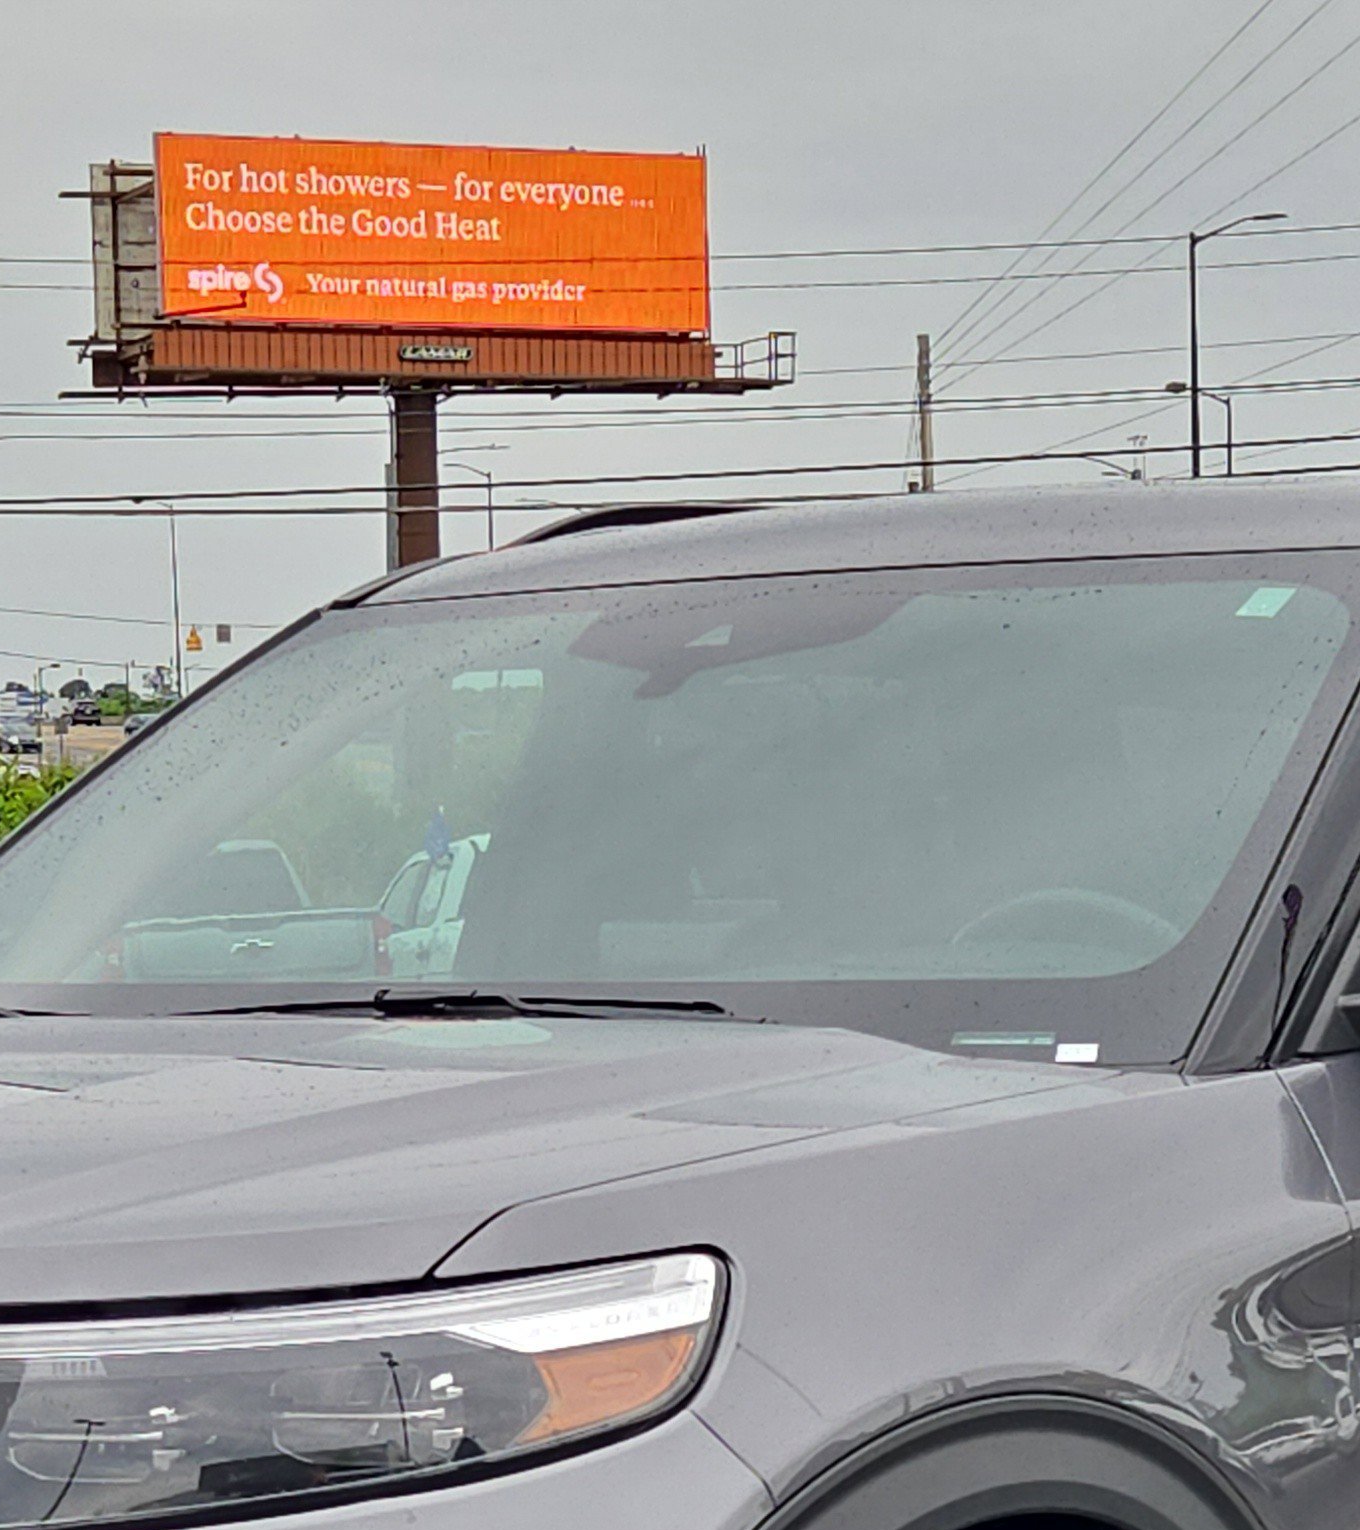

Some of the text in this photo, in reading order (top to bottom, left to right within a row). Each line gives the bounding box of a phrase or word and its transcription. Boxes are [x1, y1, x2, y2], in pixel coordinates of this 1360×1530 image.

[184, 162, 234, 192] For
[240, 163, 289, 194] hot
[295, 165, 411, 198] showers
[454, 171, 494, 201] for
[499, 180, 625, 211] everyone
[185, 202, 502, 241] Choose the Good Heat
[187, 263, 252, 297] spire
[305, 273, 586, 304] Your natural gas provider
